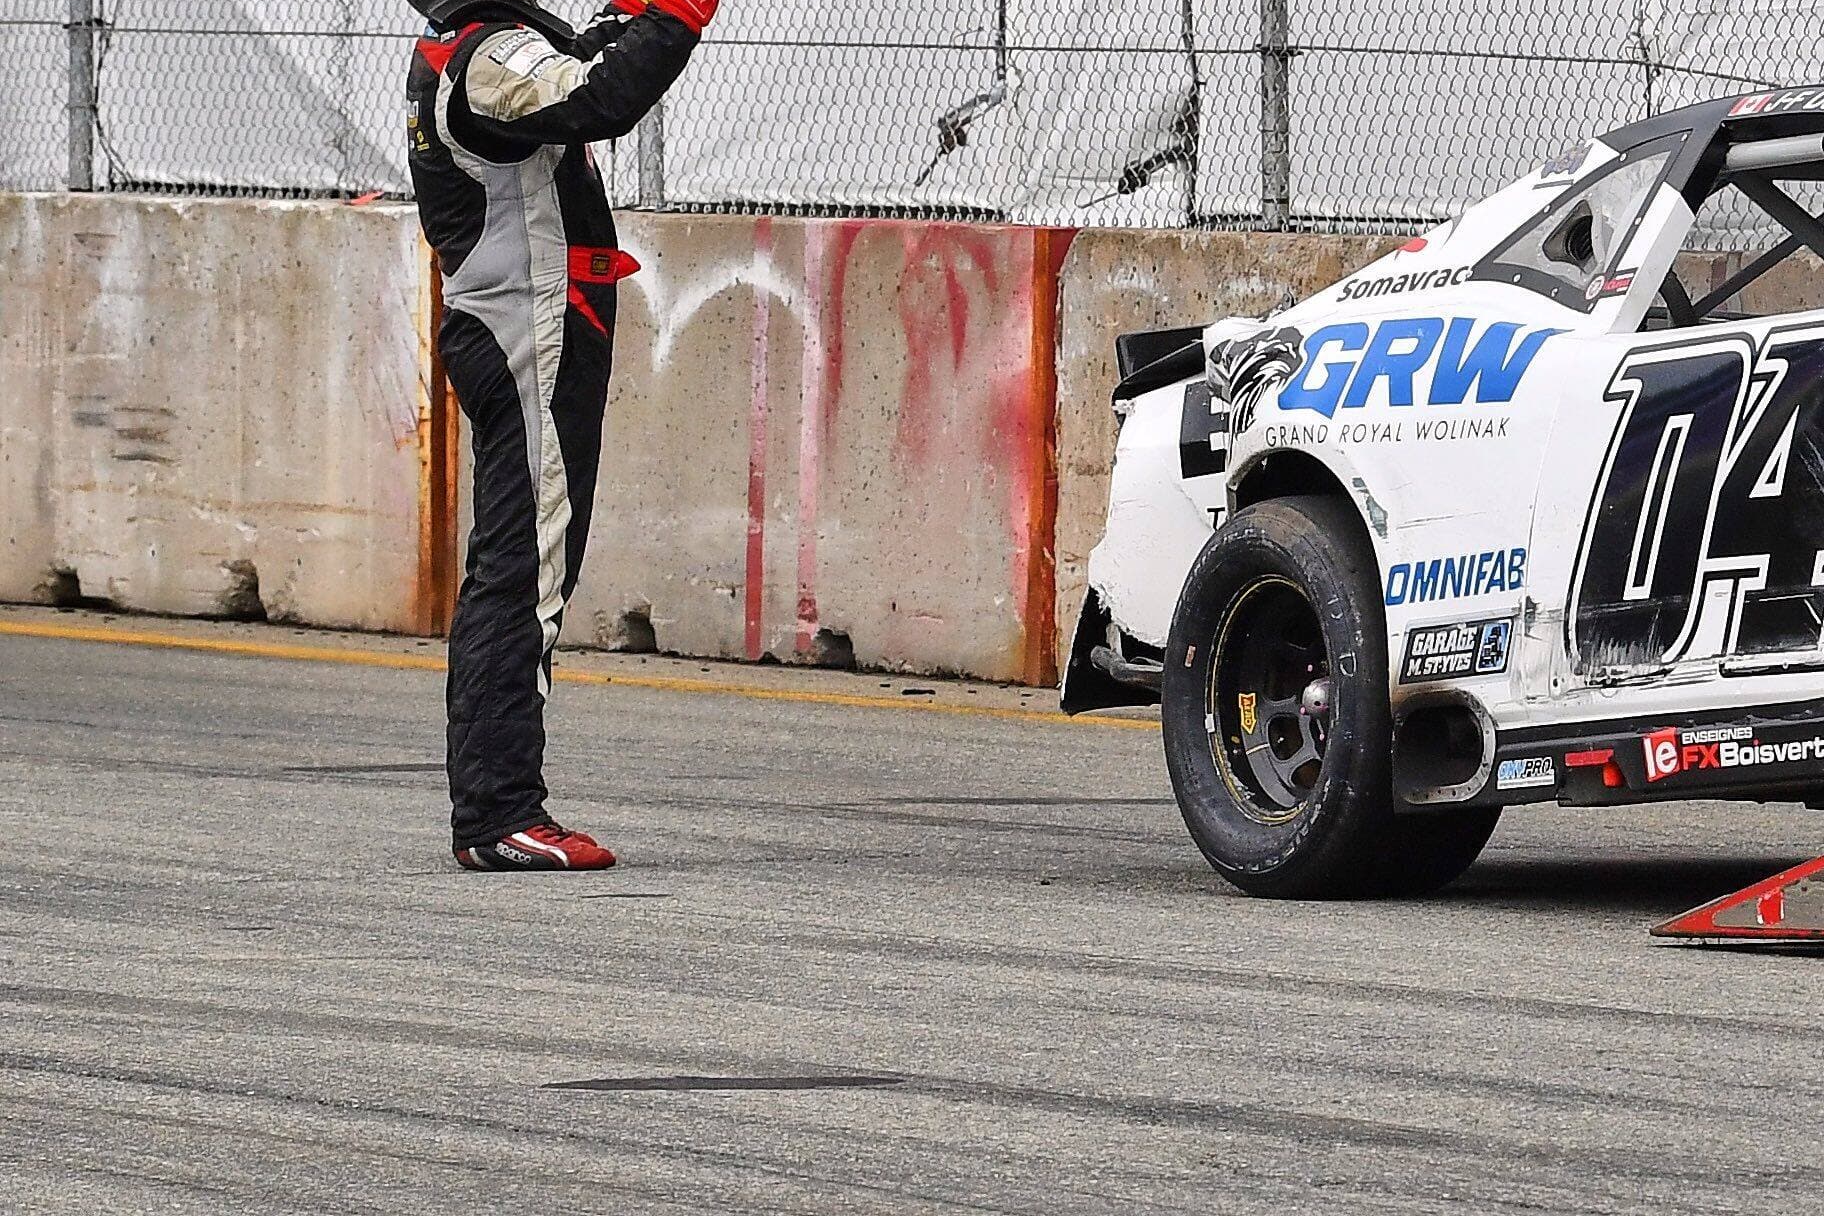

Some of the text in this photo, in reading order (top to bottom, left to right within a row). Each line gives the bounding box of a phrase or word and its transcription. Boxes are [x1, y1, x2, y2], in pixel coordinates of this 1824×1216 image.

[1277, 316, 1576, 420] GRW
[1265, 417, 1511, 448] GRAND ROYAL WOLINAK
[1385, 547, 1527, 606] OMNIFAB
[1411, 627, 1478, 656] GARAGE
[1681, 726, 1753, 744] ENSEIGNES
